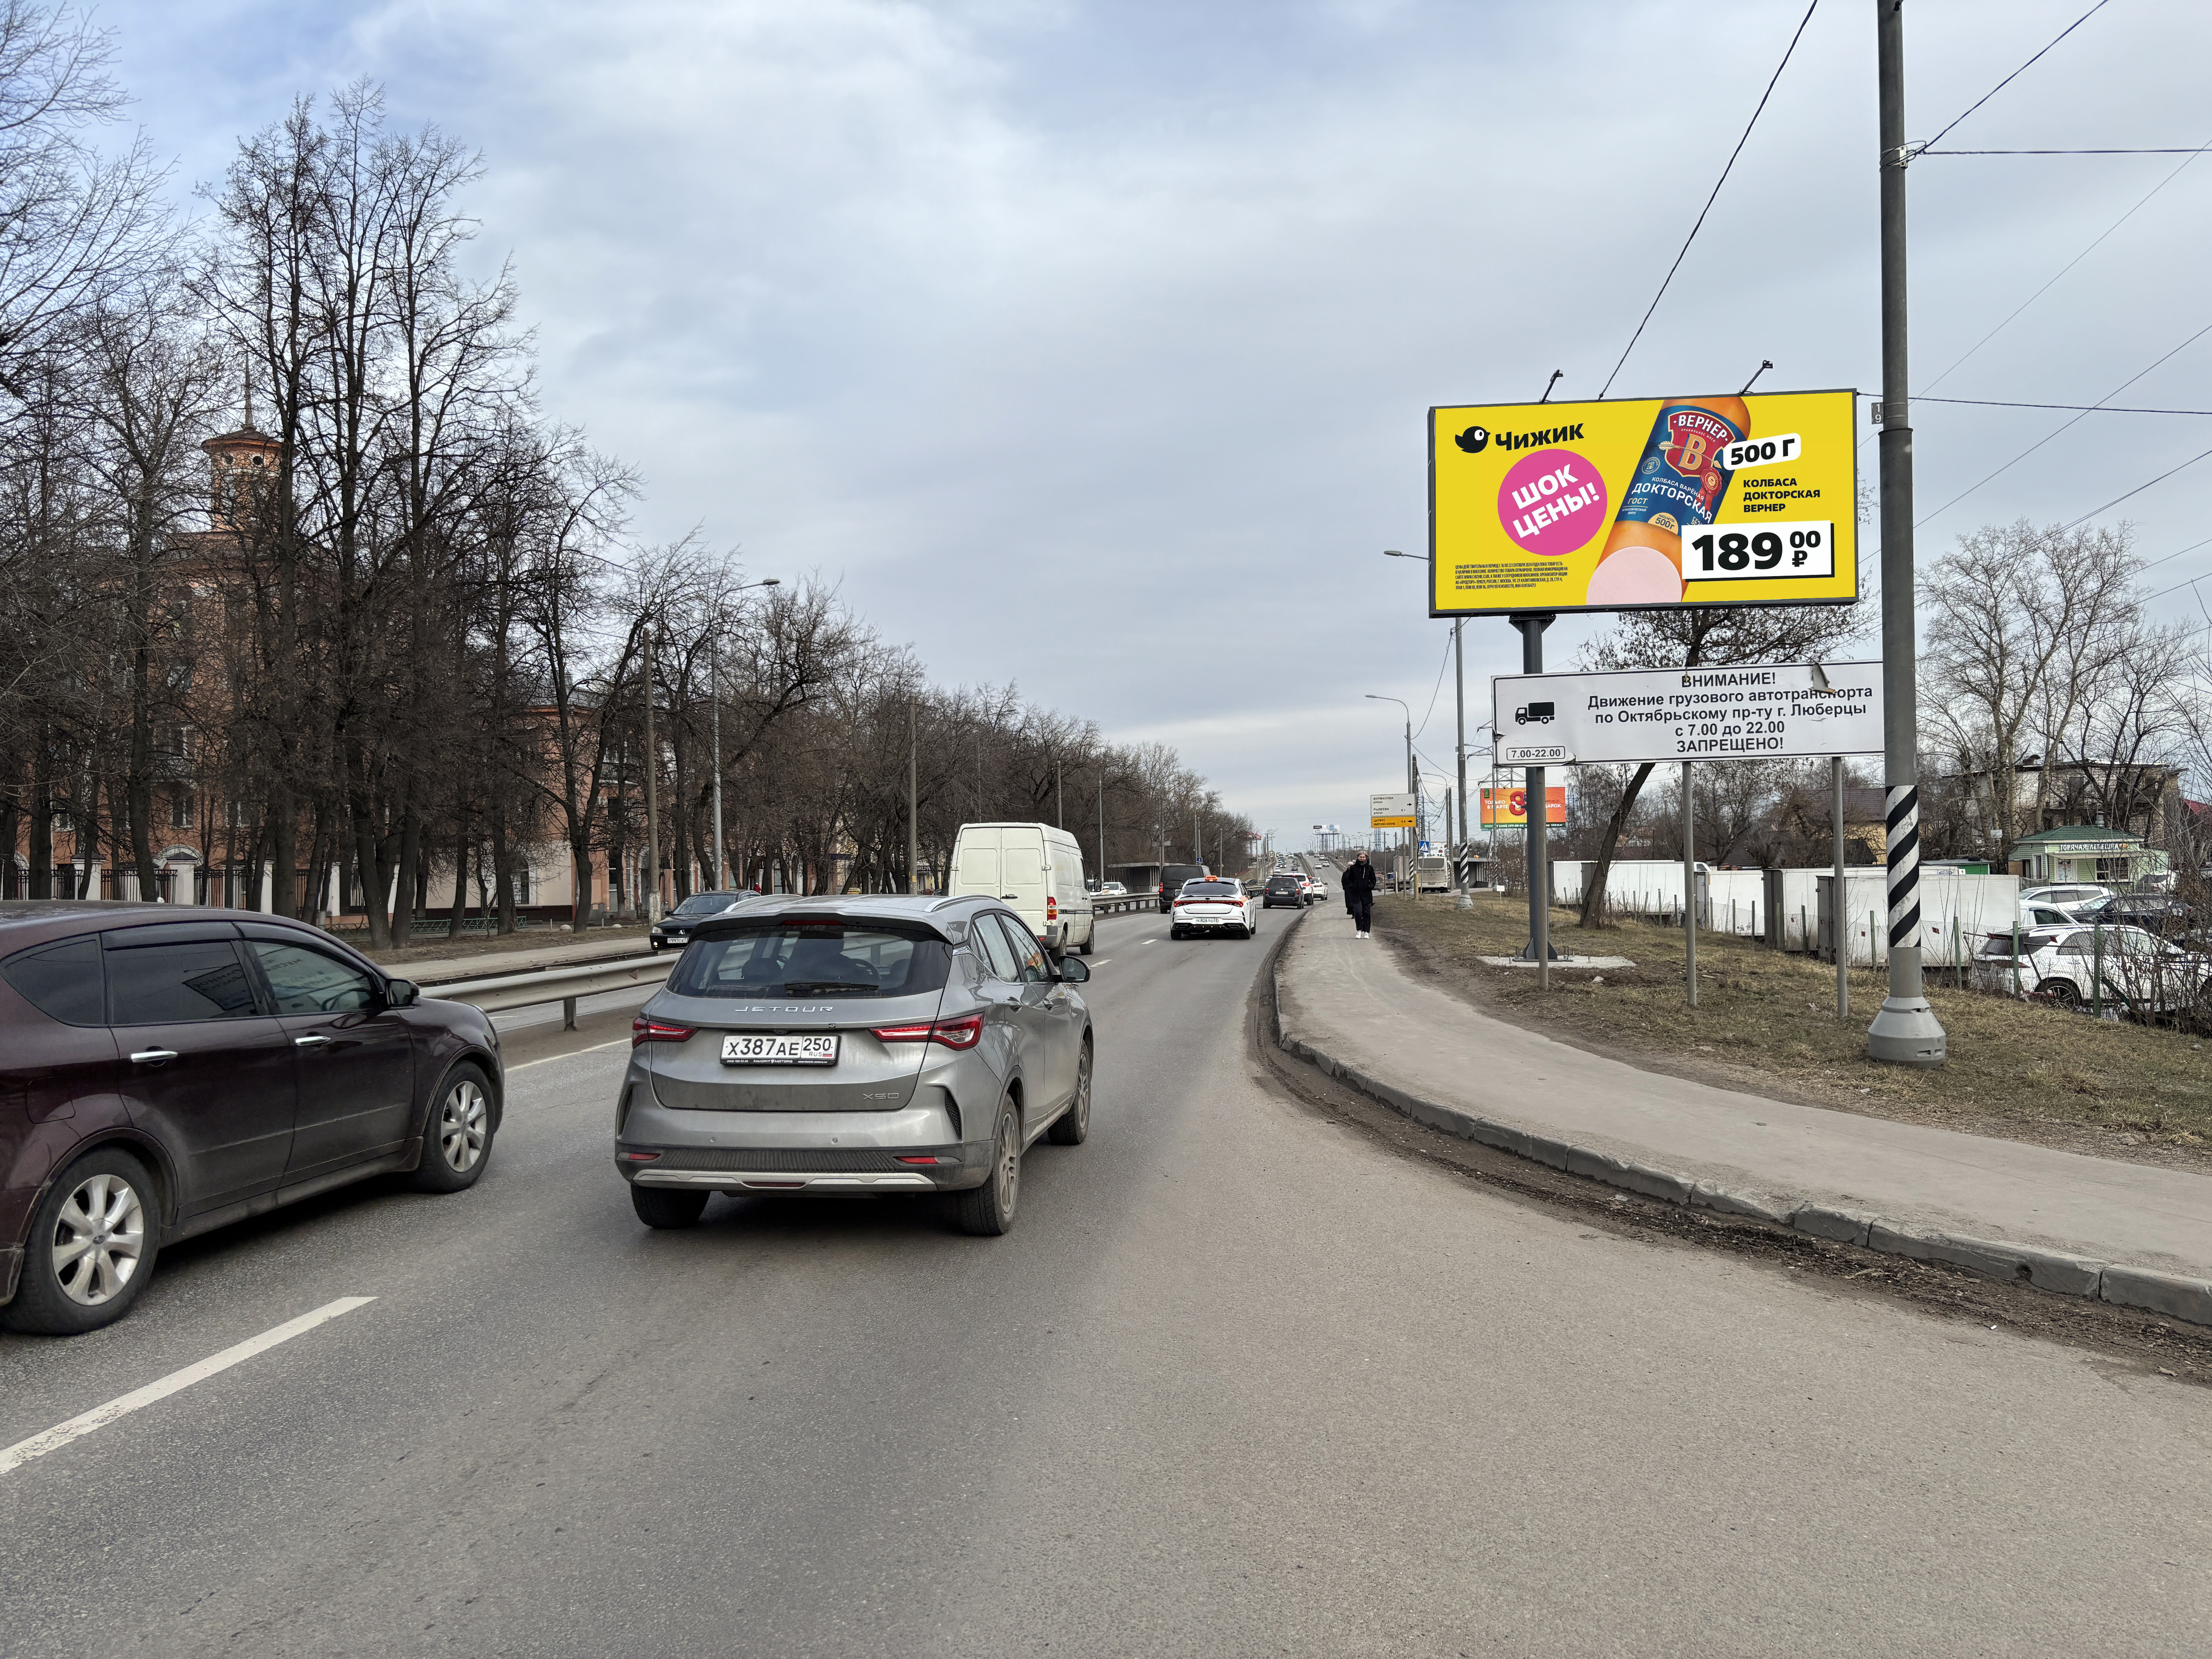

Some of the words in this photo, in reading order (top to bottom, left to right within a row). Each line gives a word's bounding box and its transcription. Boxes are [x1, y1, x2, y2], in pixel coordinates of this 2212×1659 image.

[1678, 414, 1728, 439] ВЕРНЕР
[1495, 422, 1585, 451] Чижик
[1706, 433, 1716, 443] МЯСО
[1676, 433, 1706, 471] В
[1731, 442, 1776, 465] 500
[1782, 438, 1795, 457] Г
[1511, 463, 1579, 510] ШОК
[1652, 477, 1679, 488] КОЛБАСА
[1679, 483, 1705, 501] ВАРЁНАЯ
[1743, 478, 1798, 488] КОЛБАСА
[1631, 483, 1713, 524] ДОКТОРСКАЯ
[1743, 489, 1820, 501] ДОКТОРСКАЯ
[1512, 482, 1600, 538] ЦЕНЫ!
[1743, 503, 1786, 513] ВЕРНЕР
[1790, 530, 1821, 548] 00
[1691, 531, 1783, 571] 189
[1681, 672, 1776, 688] ВНИМАНИЕ!
[1588, 696, 1664, 710] Движение
[1669, 692, 1744, 707] грузового
[1595, 714, 1613, 723] по
[1618, 709, 1727, 724] Октябрьскому
[1732, 708, 1772, 721] пр-ту
[1778, 708, 1786, 716] г.
[1791, 703, 1866, 718] Люберцы
[1675, 727, 1683, 737] с
[1688, 723, 1717, 736] 7.00
[1722, 725, 1741, 737] до
[1746, 720, 1785, 734] 22.00
[1511, 749, 1561, 758] 7.00-22.00
[1676, 737, 1783, 753] ЗАПРЕЩЕНО!
[802, 1037, 831, 1051] 250
